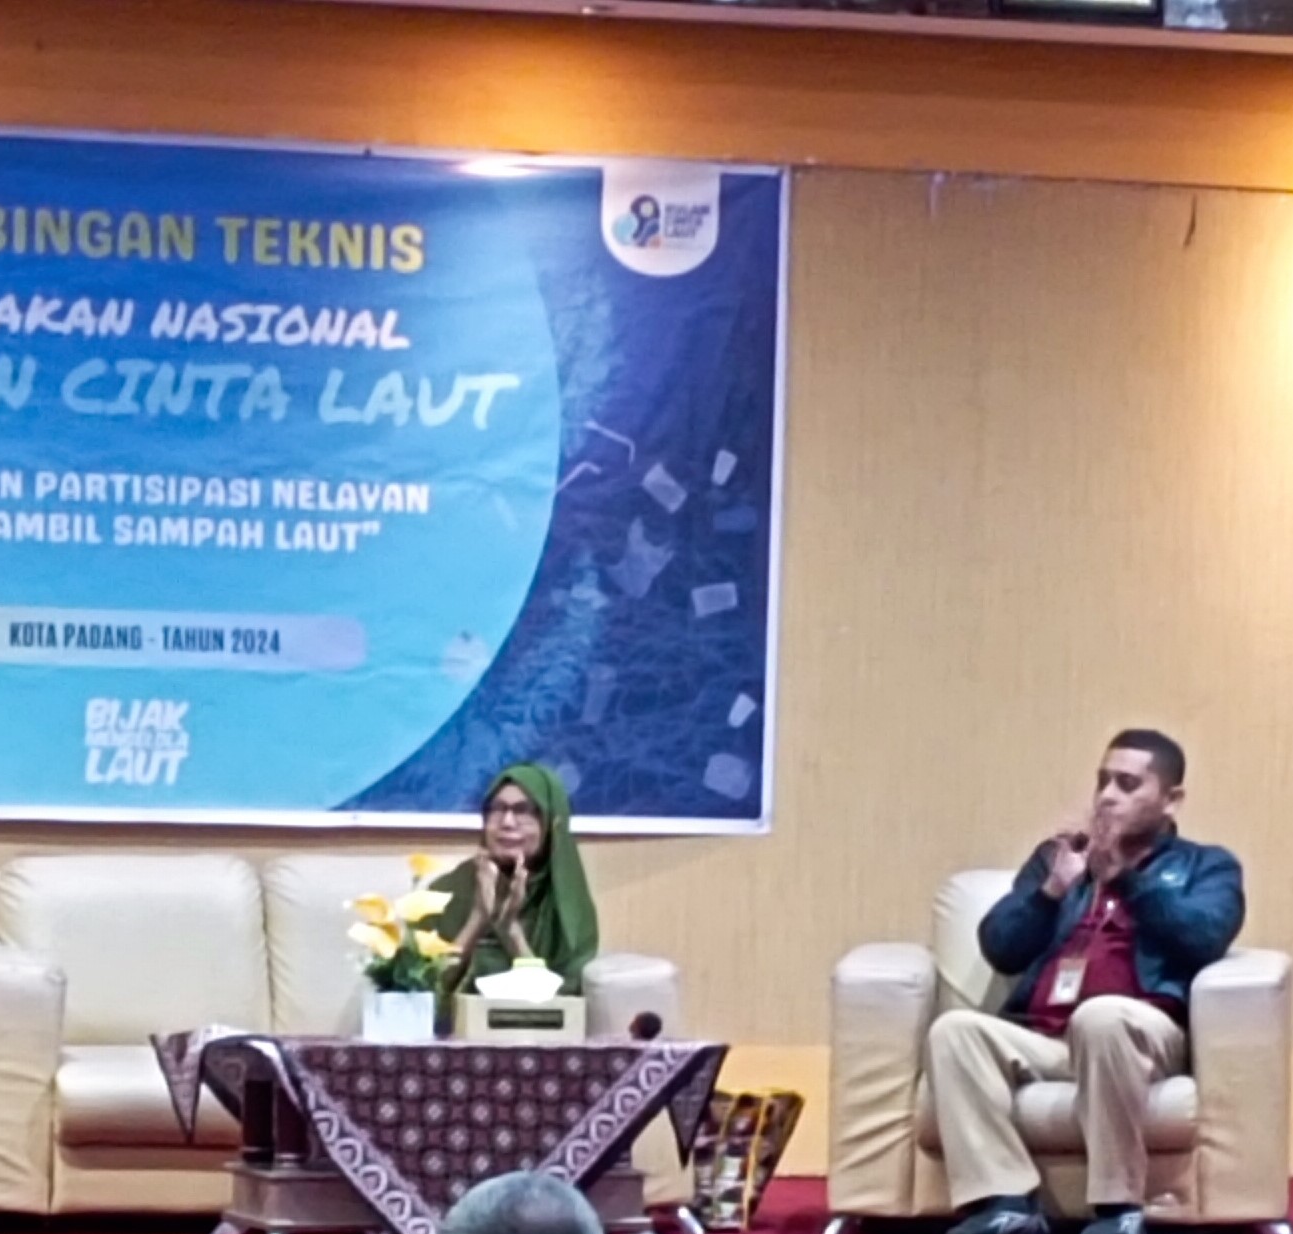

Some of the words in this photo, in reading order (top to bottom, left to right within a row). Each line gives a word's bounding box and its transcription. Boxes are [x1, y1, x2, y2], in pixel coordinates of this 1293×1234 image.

[216, 216, 425, 273] TEKNIS
[150, 298, 410, 349] NASIONAL
[61, 357, 291, 422] CINTA
[319, 368, 520, 429] LAUT
[35, 471, 260, 507] PARTISIPASI
[113, 514, 263, 549] SAMPAH
[9, 622, 56, 648] KOTA
[63, 624, 142, 650] PADANG
[162, 626, 225, 651] TAHUN
[231, 628, 280, 654] 2024
[86, 698, 189, 731] BIJAK
[86, 748, 189, 785] LAUT
